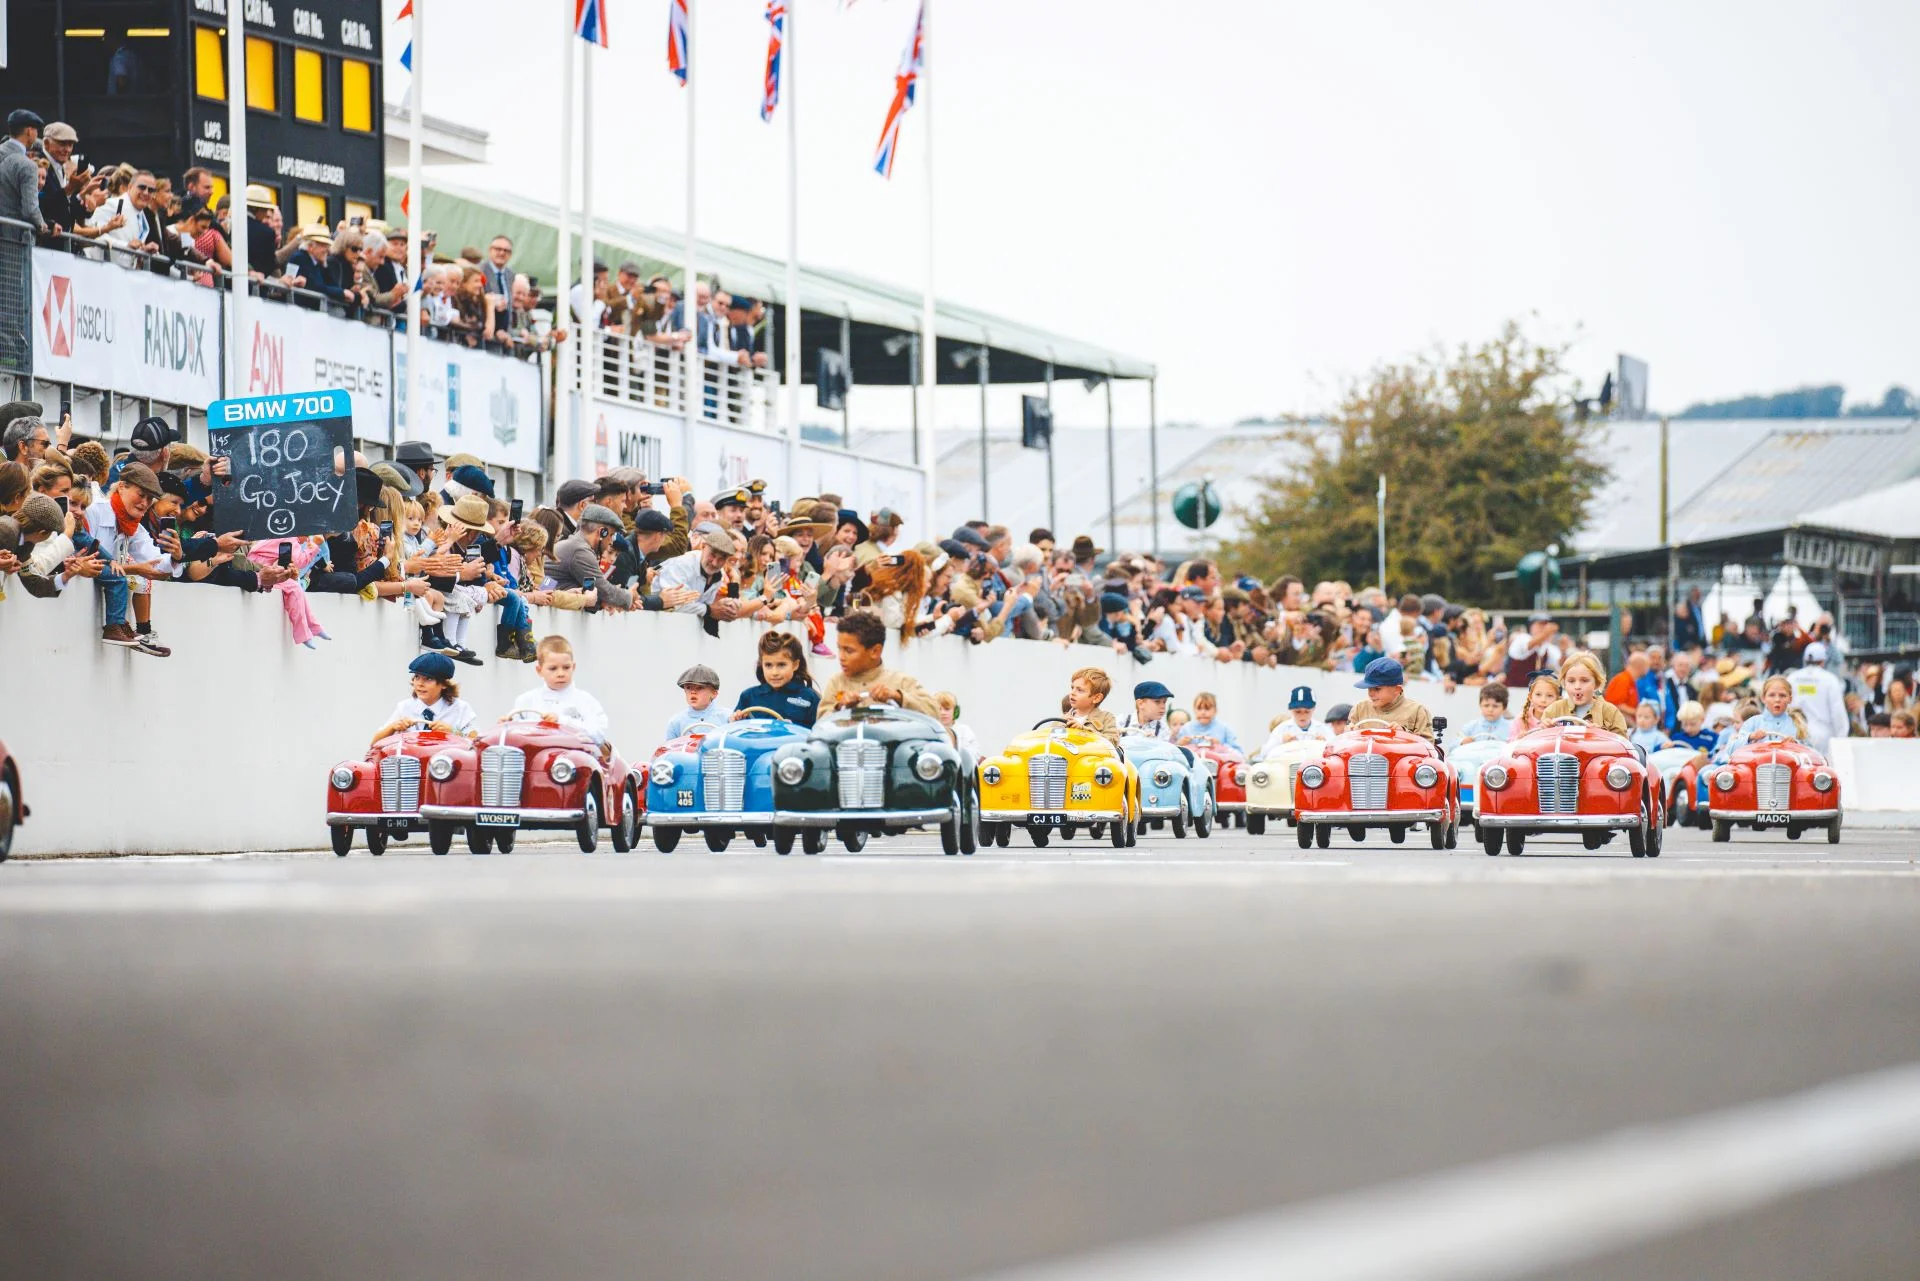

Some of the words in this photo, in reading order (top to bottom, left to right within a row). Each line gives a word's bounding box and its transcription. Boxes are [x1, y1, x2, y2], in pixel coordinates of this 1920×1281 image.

[293, 8, 311, 37] CAR
[310, 12, 325, 40] No.
[341, 19, 359, 47] CAR
[358, 23, 373, 50] No.
[204, 120, 222, 141] LAPS
[277, 155, 295, 177] LAPS
[319, 164, 345, 187] LEADER
[76, 303, 102, 342] HSBC
[144, 304, 206, 377] RANDOX
[249, 319, 284, 396] AON
[224, 400, 286, 422] BMW
[292, 396, 334, 416] 700
[249, 429, 308, 467] 180
[284, 471, 345, 513] JOEY
[677, 798, 693, 806] 405
[480, 814, 517, 823] WOSPY
[1033, 815, 1045, 824] CJ
[1049, 815, 1061, 824] 18
[1757, 814, 1790, 823] MADC1
